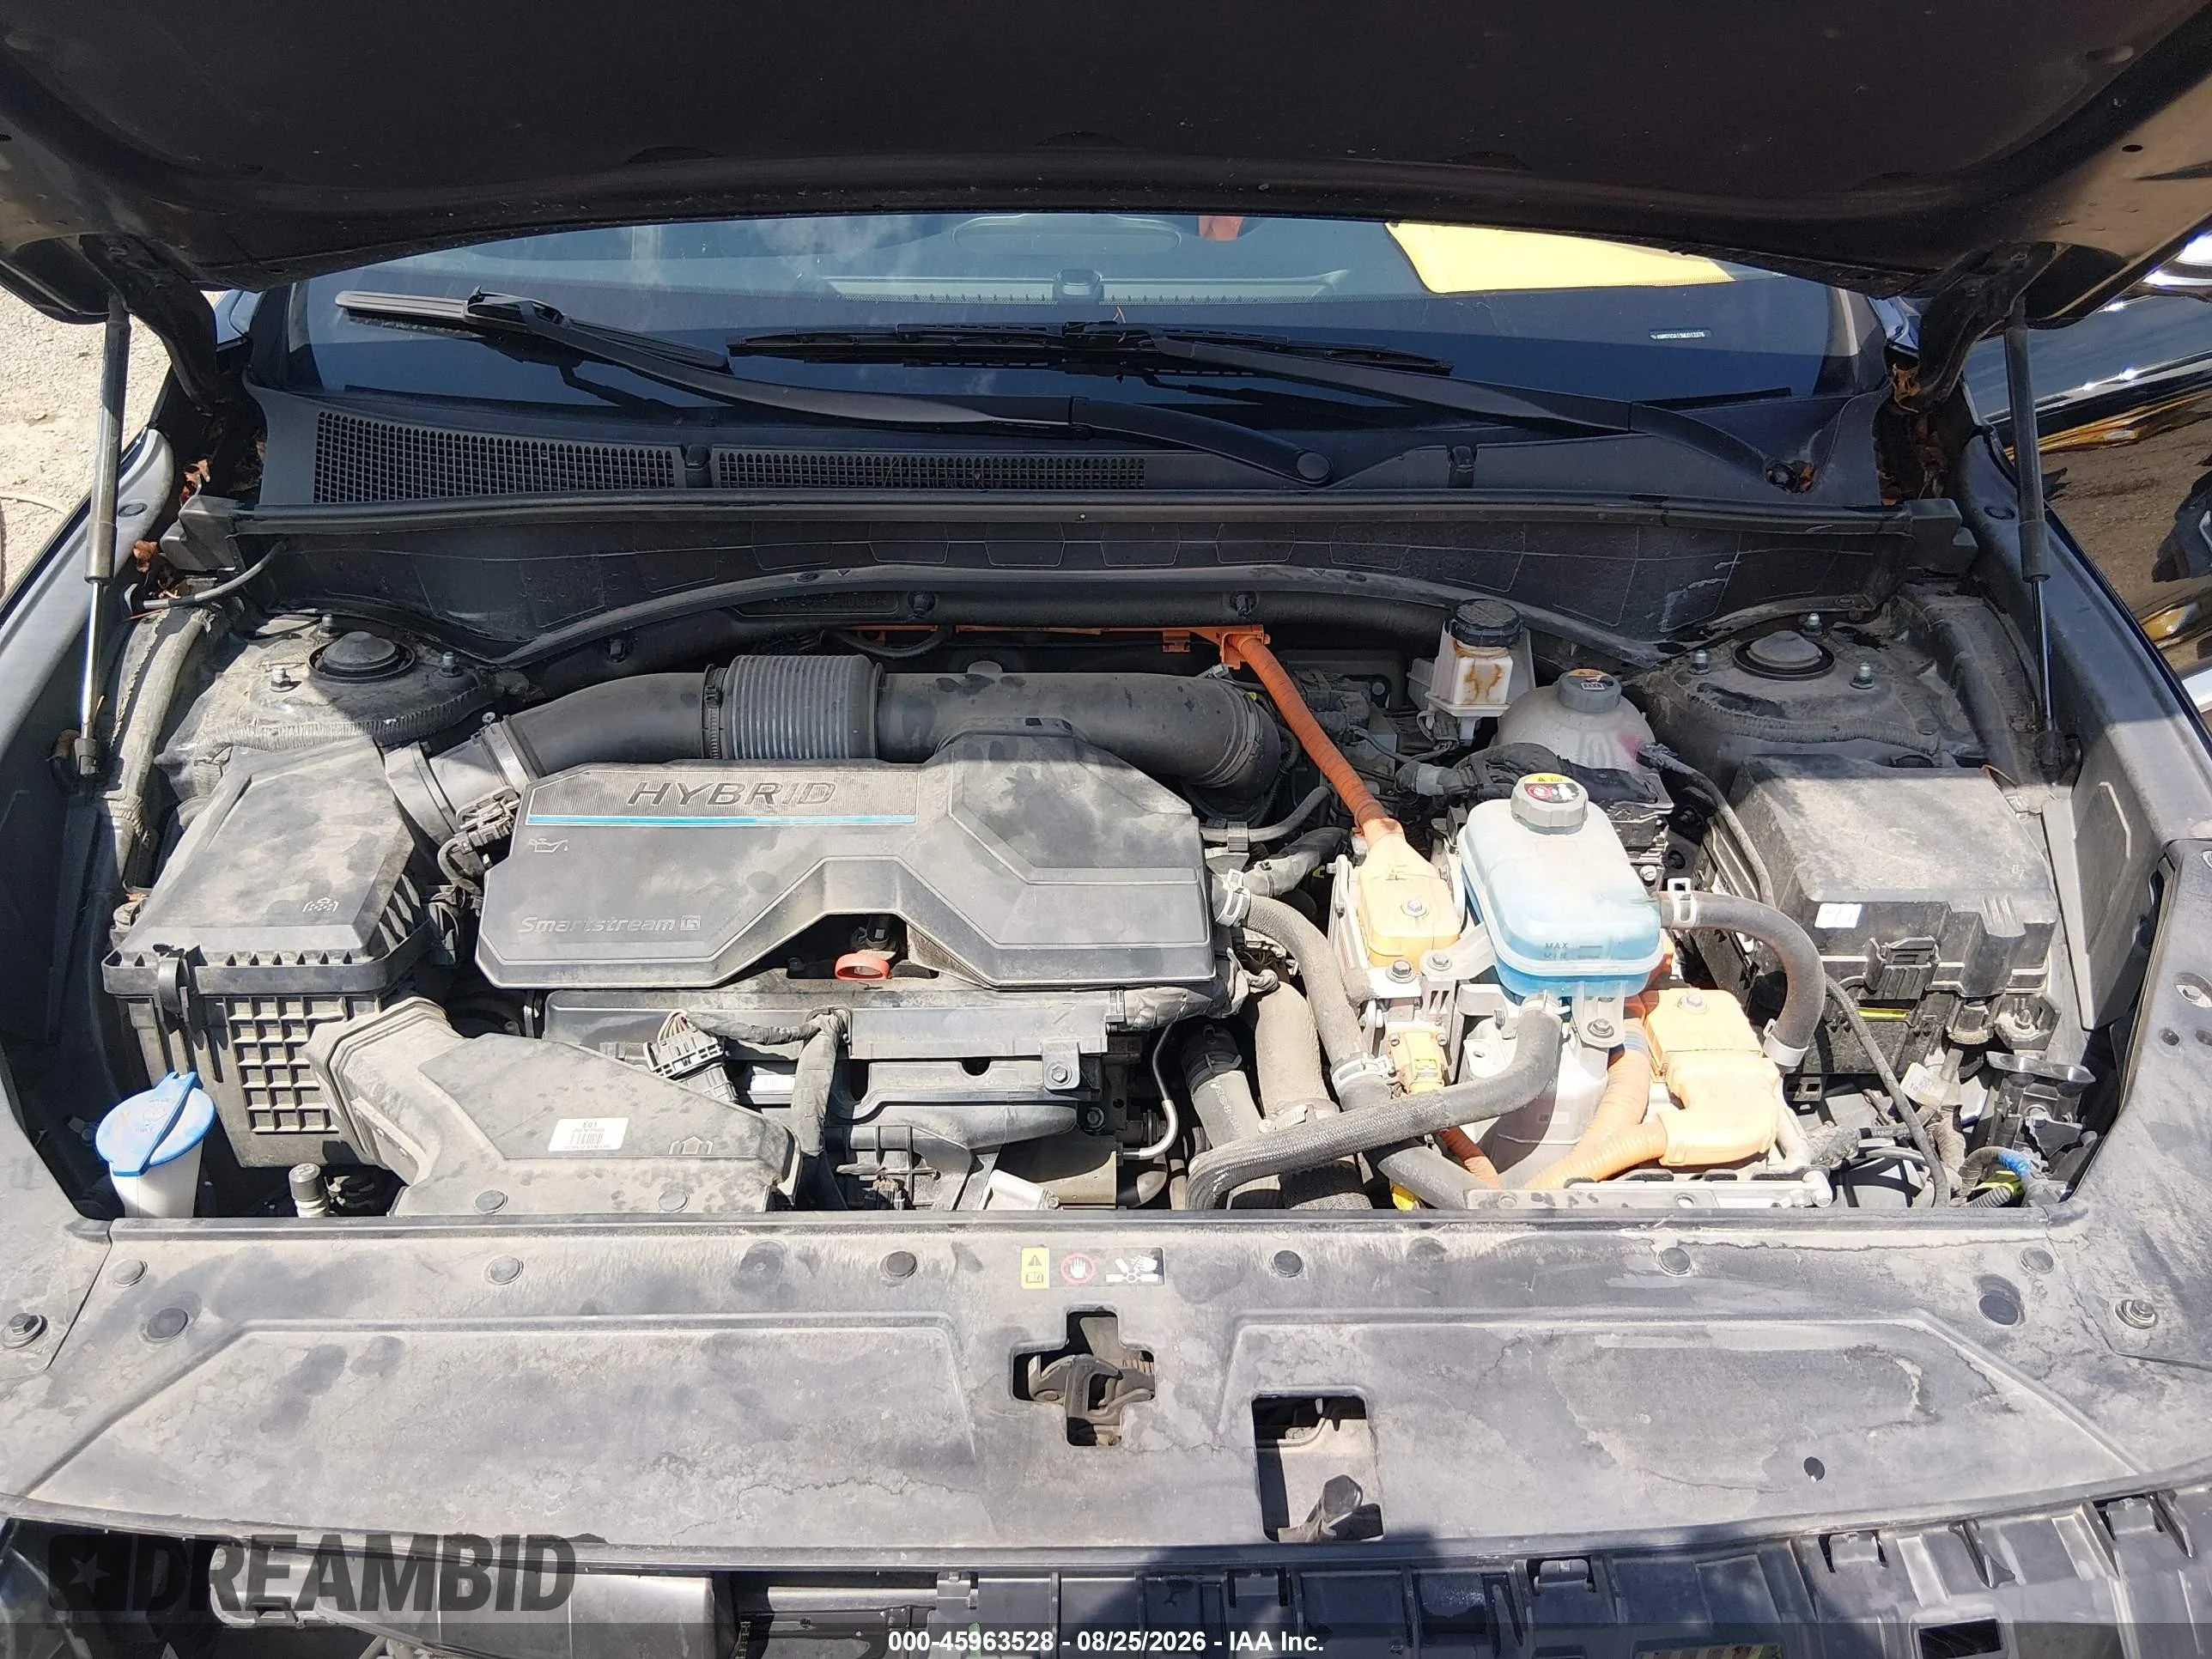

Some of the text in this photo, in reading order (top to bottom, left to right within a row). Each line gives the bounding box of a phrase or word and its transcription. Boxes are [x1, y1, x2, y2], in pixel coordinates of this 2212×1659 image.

[626, 781, 836, 806] HYBRID
[518, 916, 675, 933] Smartstream
[1545, 941, 1569, 950] MAX
